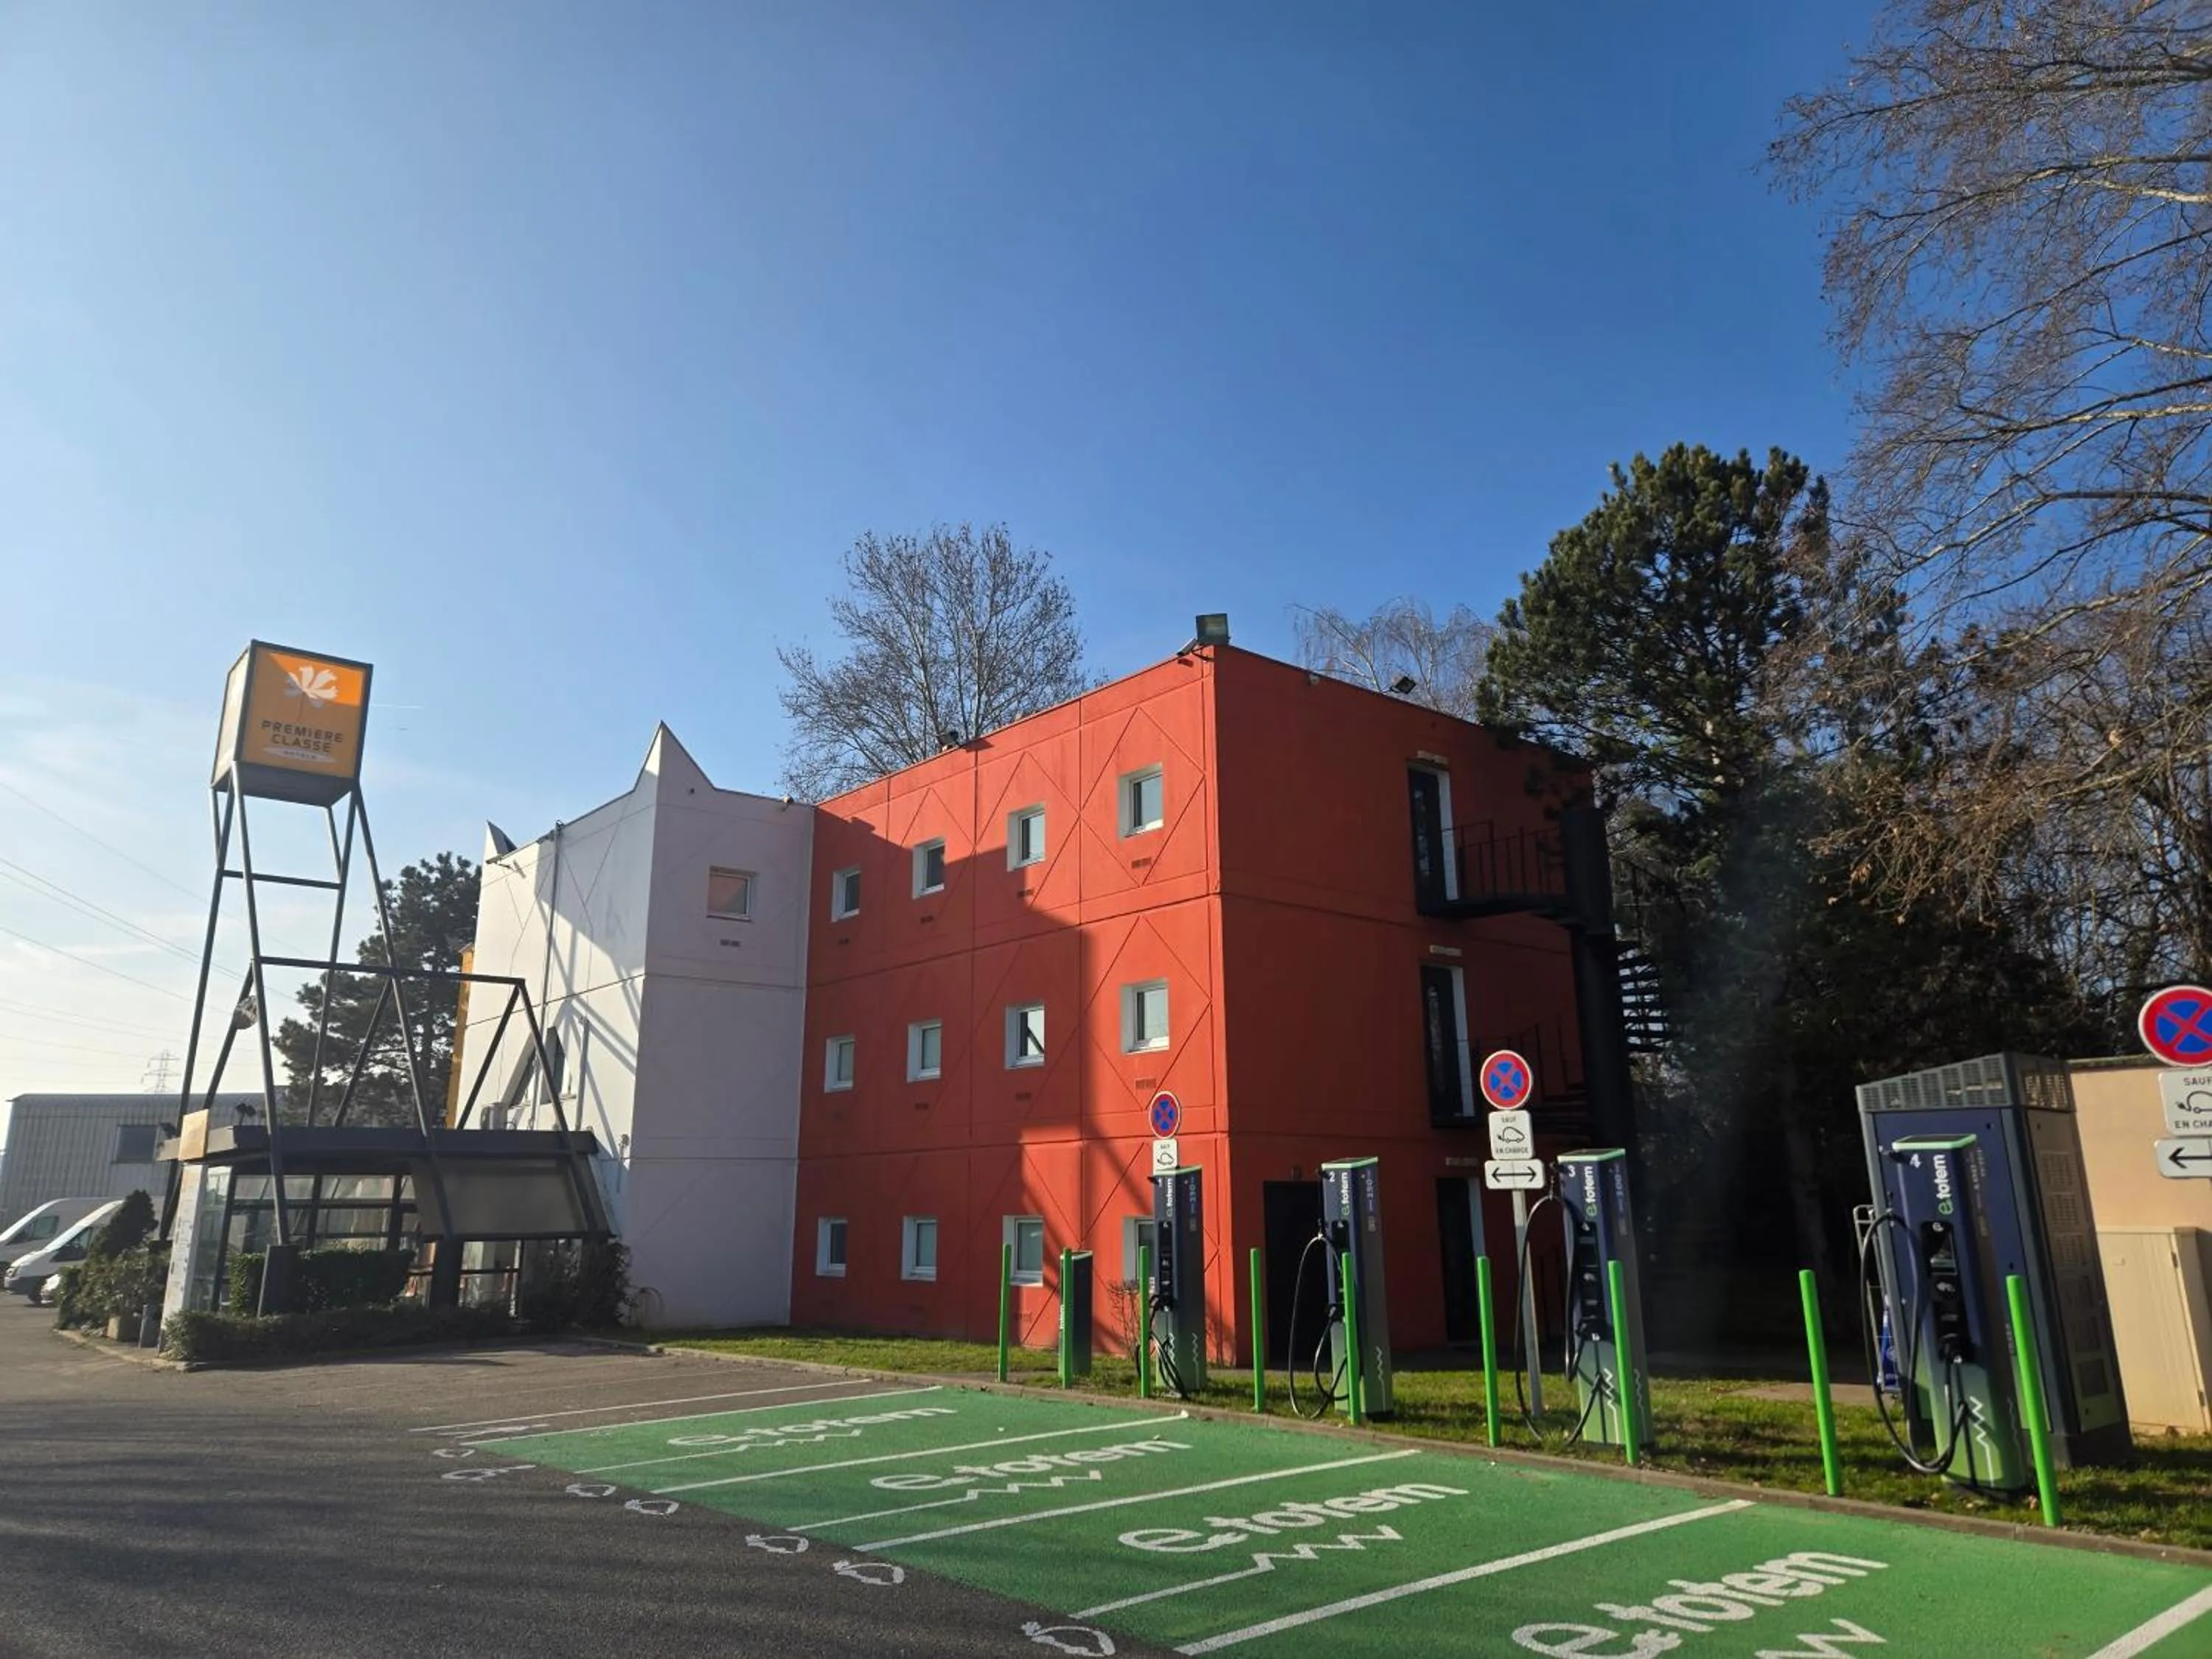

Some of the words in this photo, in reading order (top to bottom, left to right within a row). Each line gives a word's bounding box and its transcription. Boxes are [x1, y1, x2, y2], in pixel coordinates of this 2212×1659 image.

[261, 720, 343, 743] PREMIERE
[271, 734, 332, 753] CLASSE
[2174, 1120, 2189, 1129] EN
[1910, 1153, 1921, 1169] 4
[1329, 1171, 1335, 1183] 2
[1568, 1165, 1576, 1178] 3
